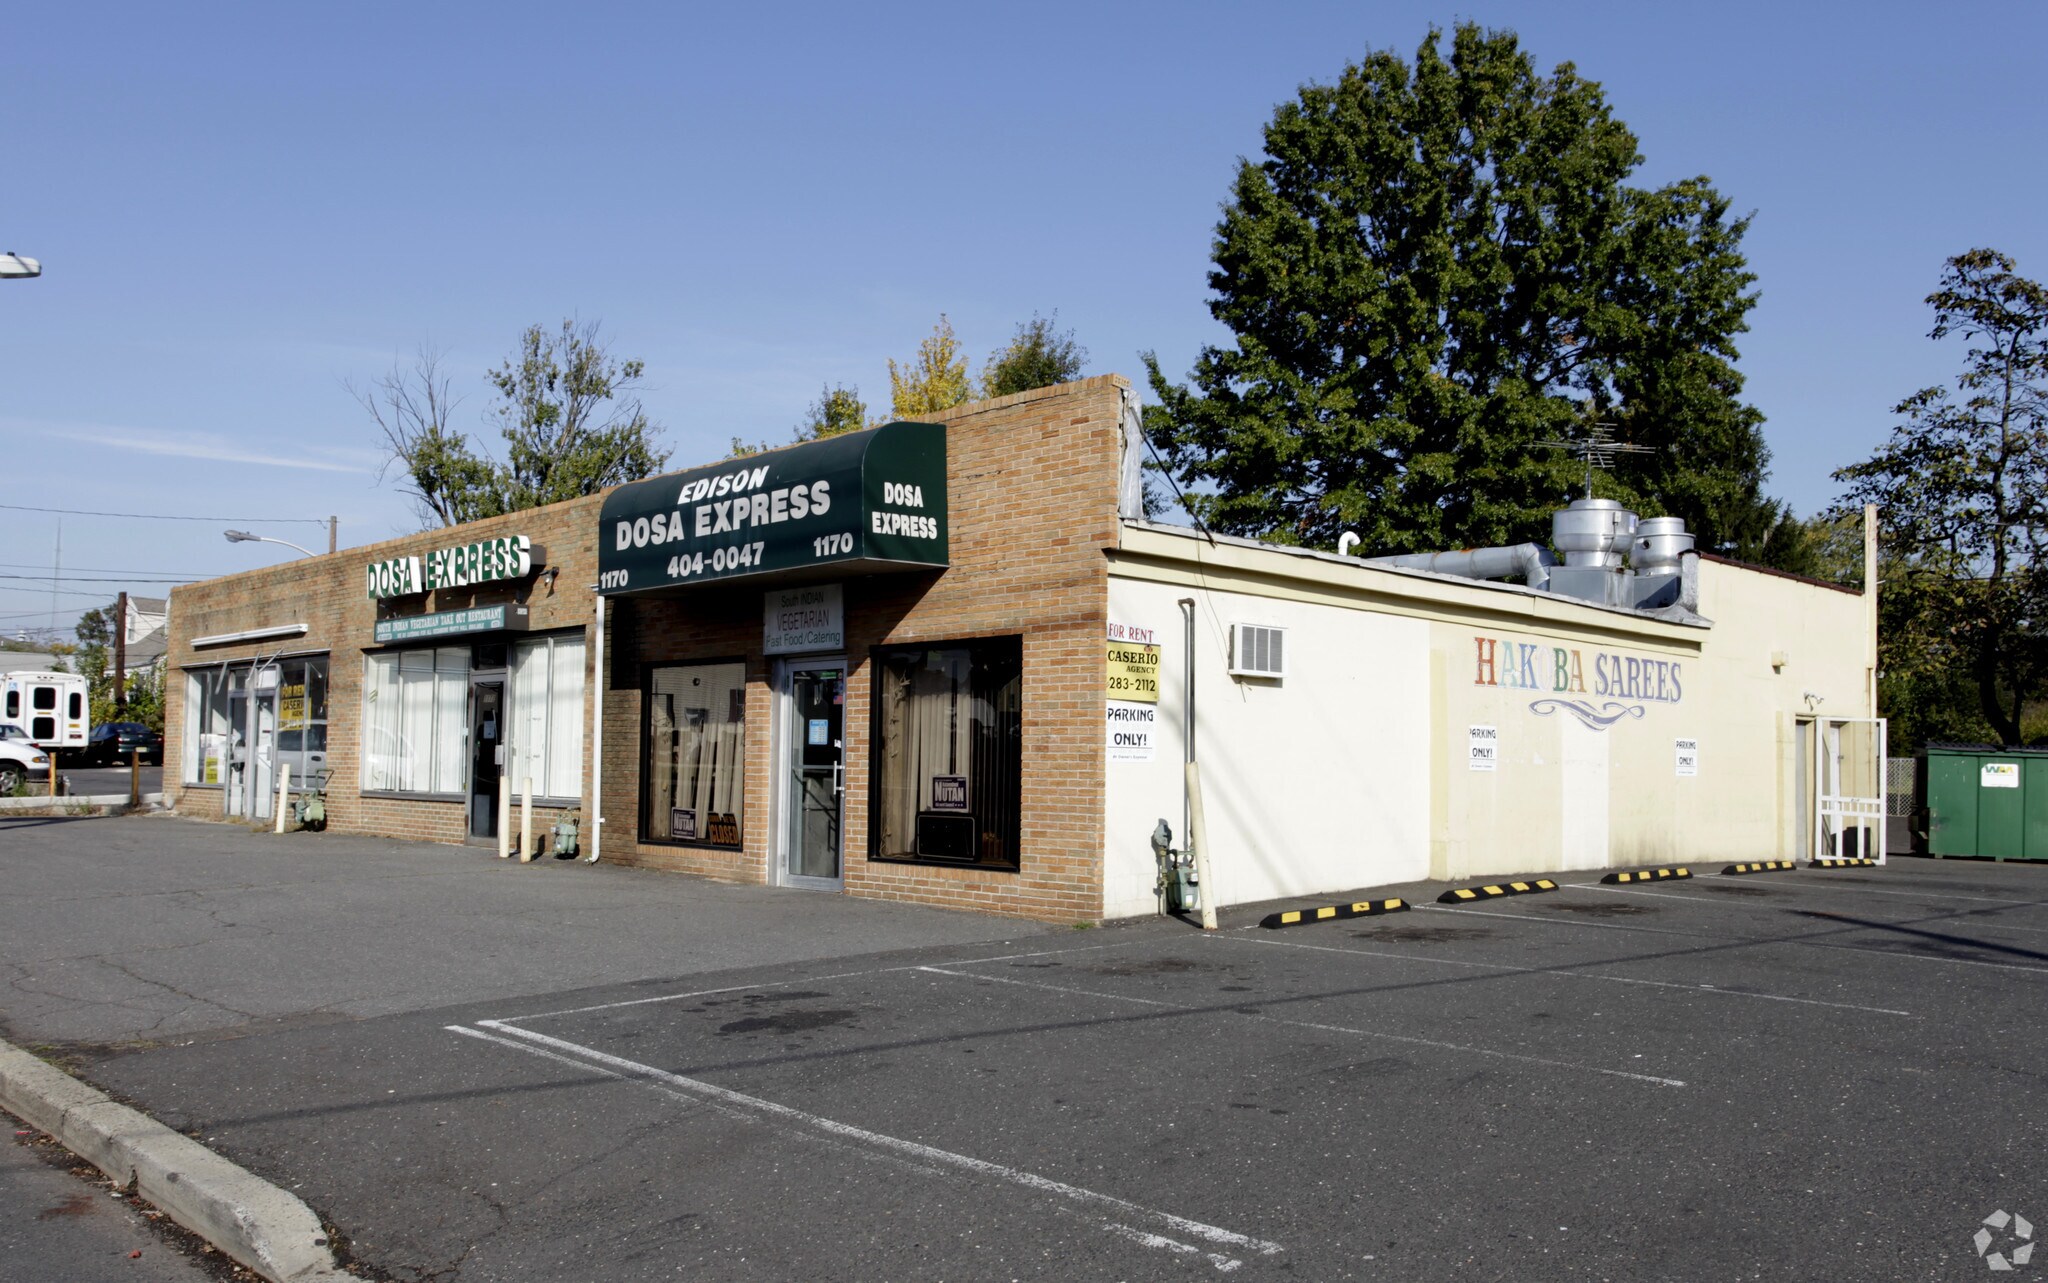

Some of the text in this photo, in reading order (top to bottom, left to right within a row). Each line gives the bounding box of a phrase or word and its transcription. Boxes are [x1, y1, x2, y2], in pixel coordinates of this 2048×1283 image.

[677, 465, 769, 505] EDISON
[884, 482, 924, 508] DOSA
[616, 480, 830, 551] DOSA EXPRESS
[872, 511, 937, 540] EXPRESS
[814, 532, 853, 557] 1170
[367, 535, 525, 599] DOSA EXPRESS
[667, 541, 765, 578] 404-0047
[600, 569, 628, 589] 1170
[781, 591, 824, 608] South INDIAN
[410, 616, 438, 629] VEGETARIAN
[440, 614, 453, 625] TAKE
[455, 612, 465, 623] OUT
[468, 608, 501, 622] RESTAURANT
[777, 608, 829, 631] VEGETARIAN
[766, 631, 840, 648] Fast Food/Catering
[1108, 623, 1154, 643] FOR RENT
[1108, 650, 1158, 665] CASERIO
[1126, 666, 1156, 674] AGENCY
[1474, 637, 1682, 703] HAKOBA SAREES
[1109, 677, 1156, 692] 283-2112
[1108, 708, 1154, 722] PARKING
[1114, 733, 1147, 747] ONLY!
[1472, 747, 1493, 758] ONLY!
[935, 782, 964, 802] NUTAN
[674, 812, 694, 831] NUTAN
[711, 824, 739, 845] CLOSED
